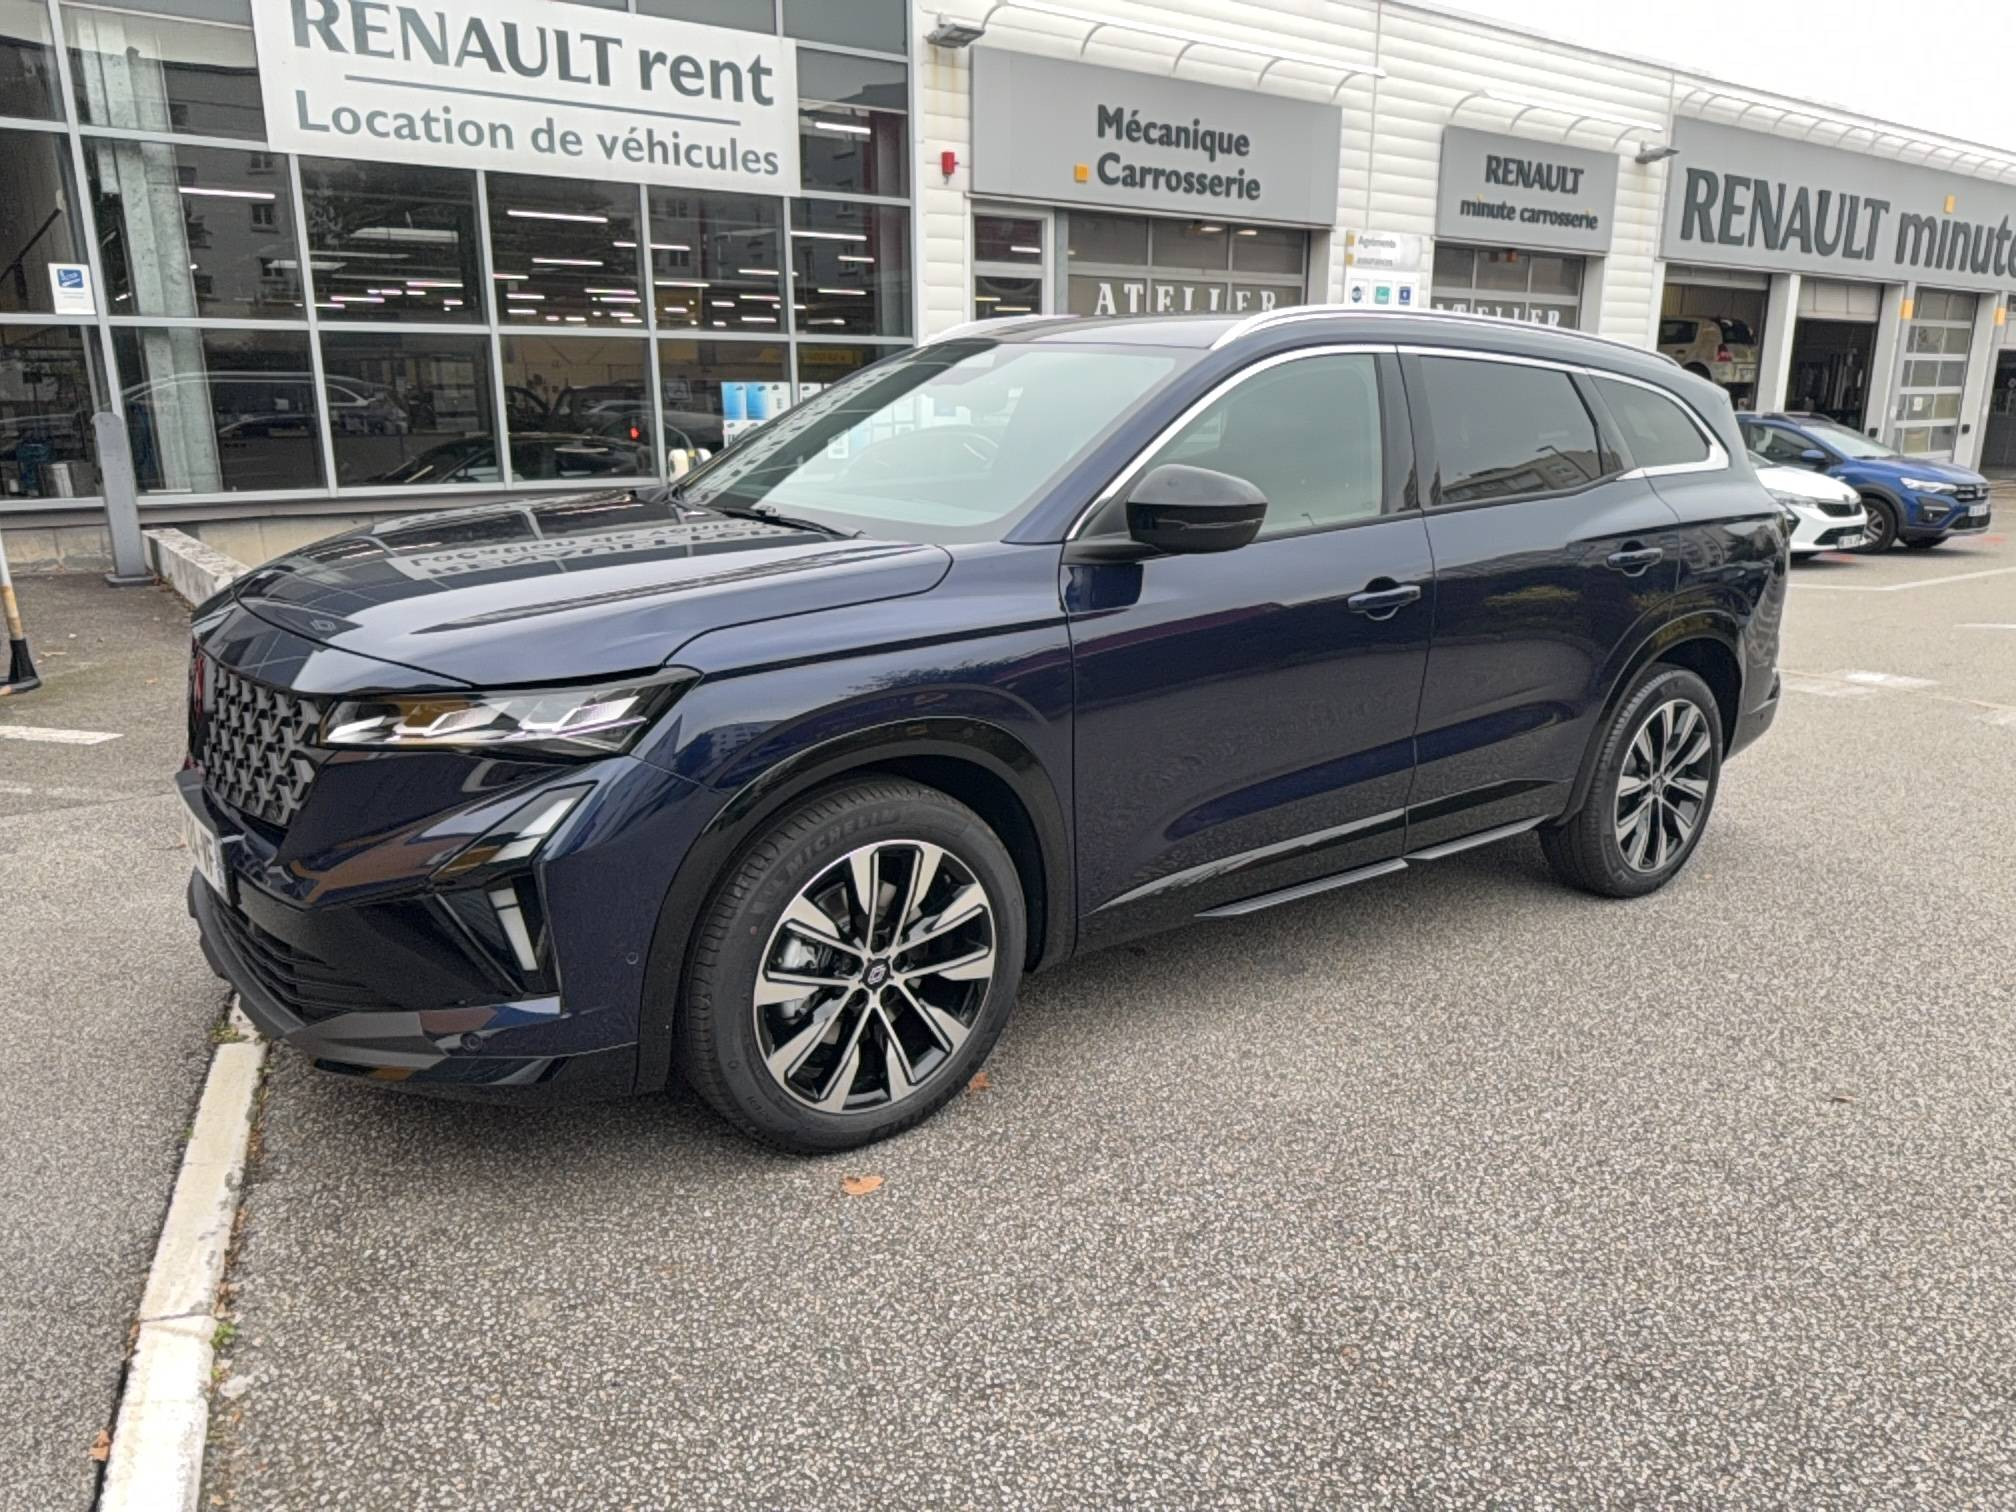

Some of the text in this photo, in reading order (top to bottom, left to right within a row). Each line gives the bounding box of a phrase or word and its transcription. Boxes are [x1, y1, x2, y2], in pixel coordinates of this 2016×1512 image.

[292, 0, 775, 107] RENAULT rent
[295, 89, 780, 176] Location de véhicules
[1098, 104, 1250, 162] Mécanique
[1097, 152, 1261, 201] Carrosserie
[1485, 154, 1585, 195] RENAULT
[1460, 193, 1599, 230] minute carrosserie
[1680, 167, 1891, 261] RENAULT
